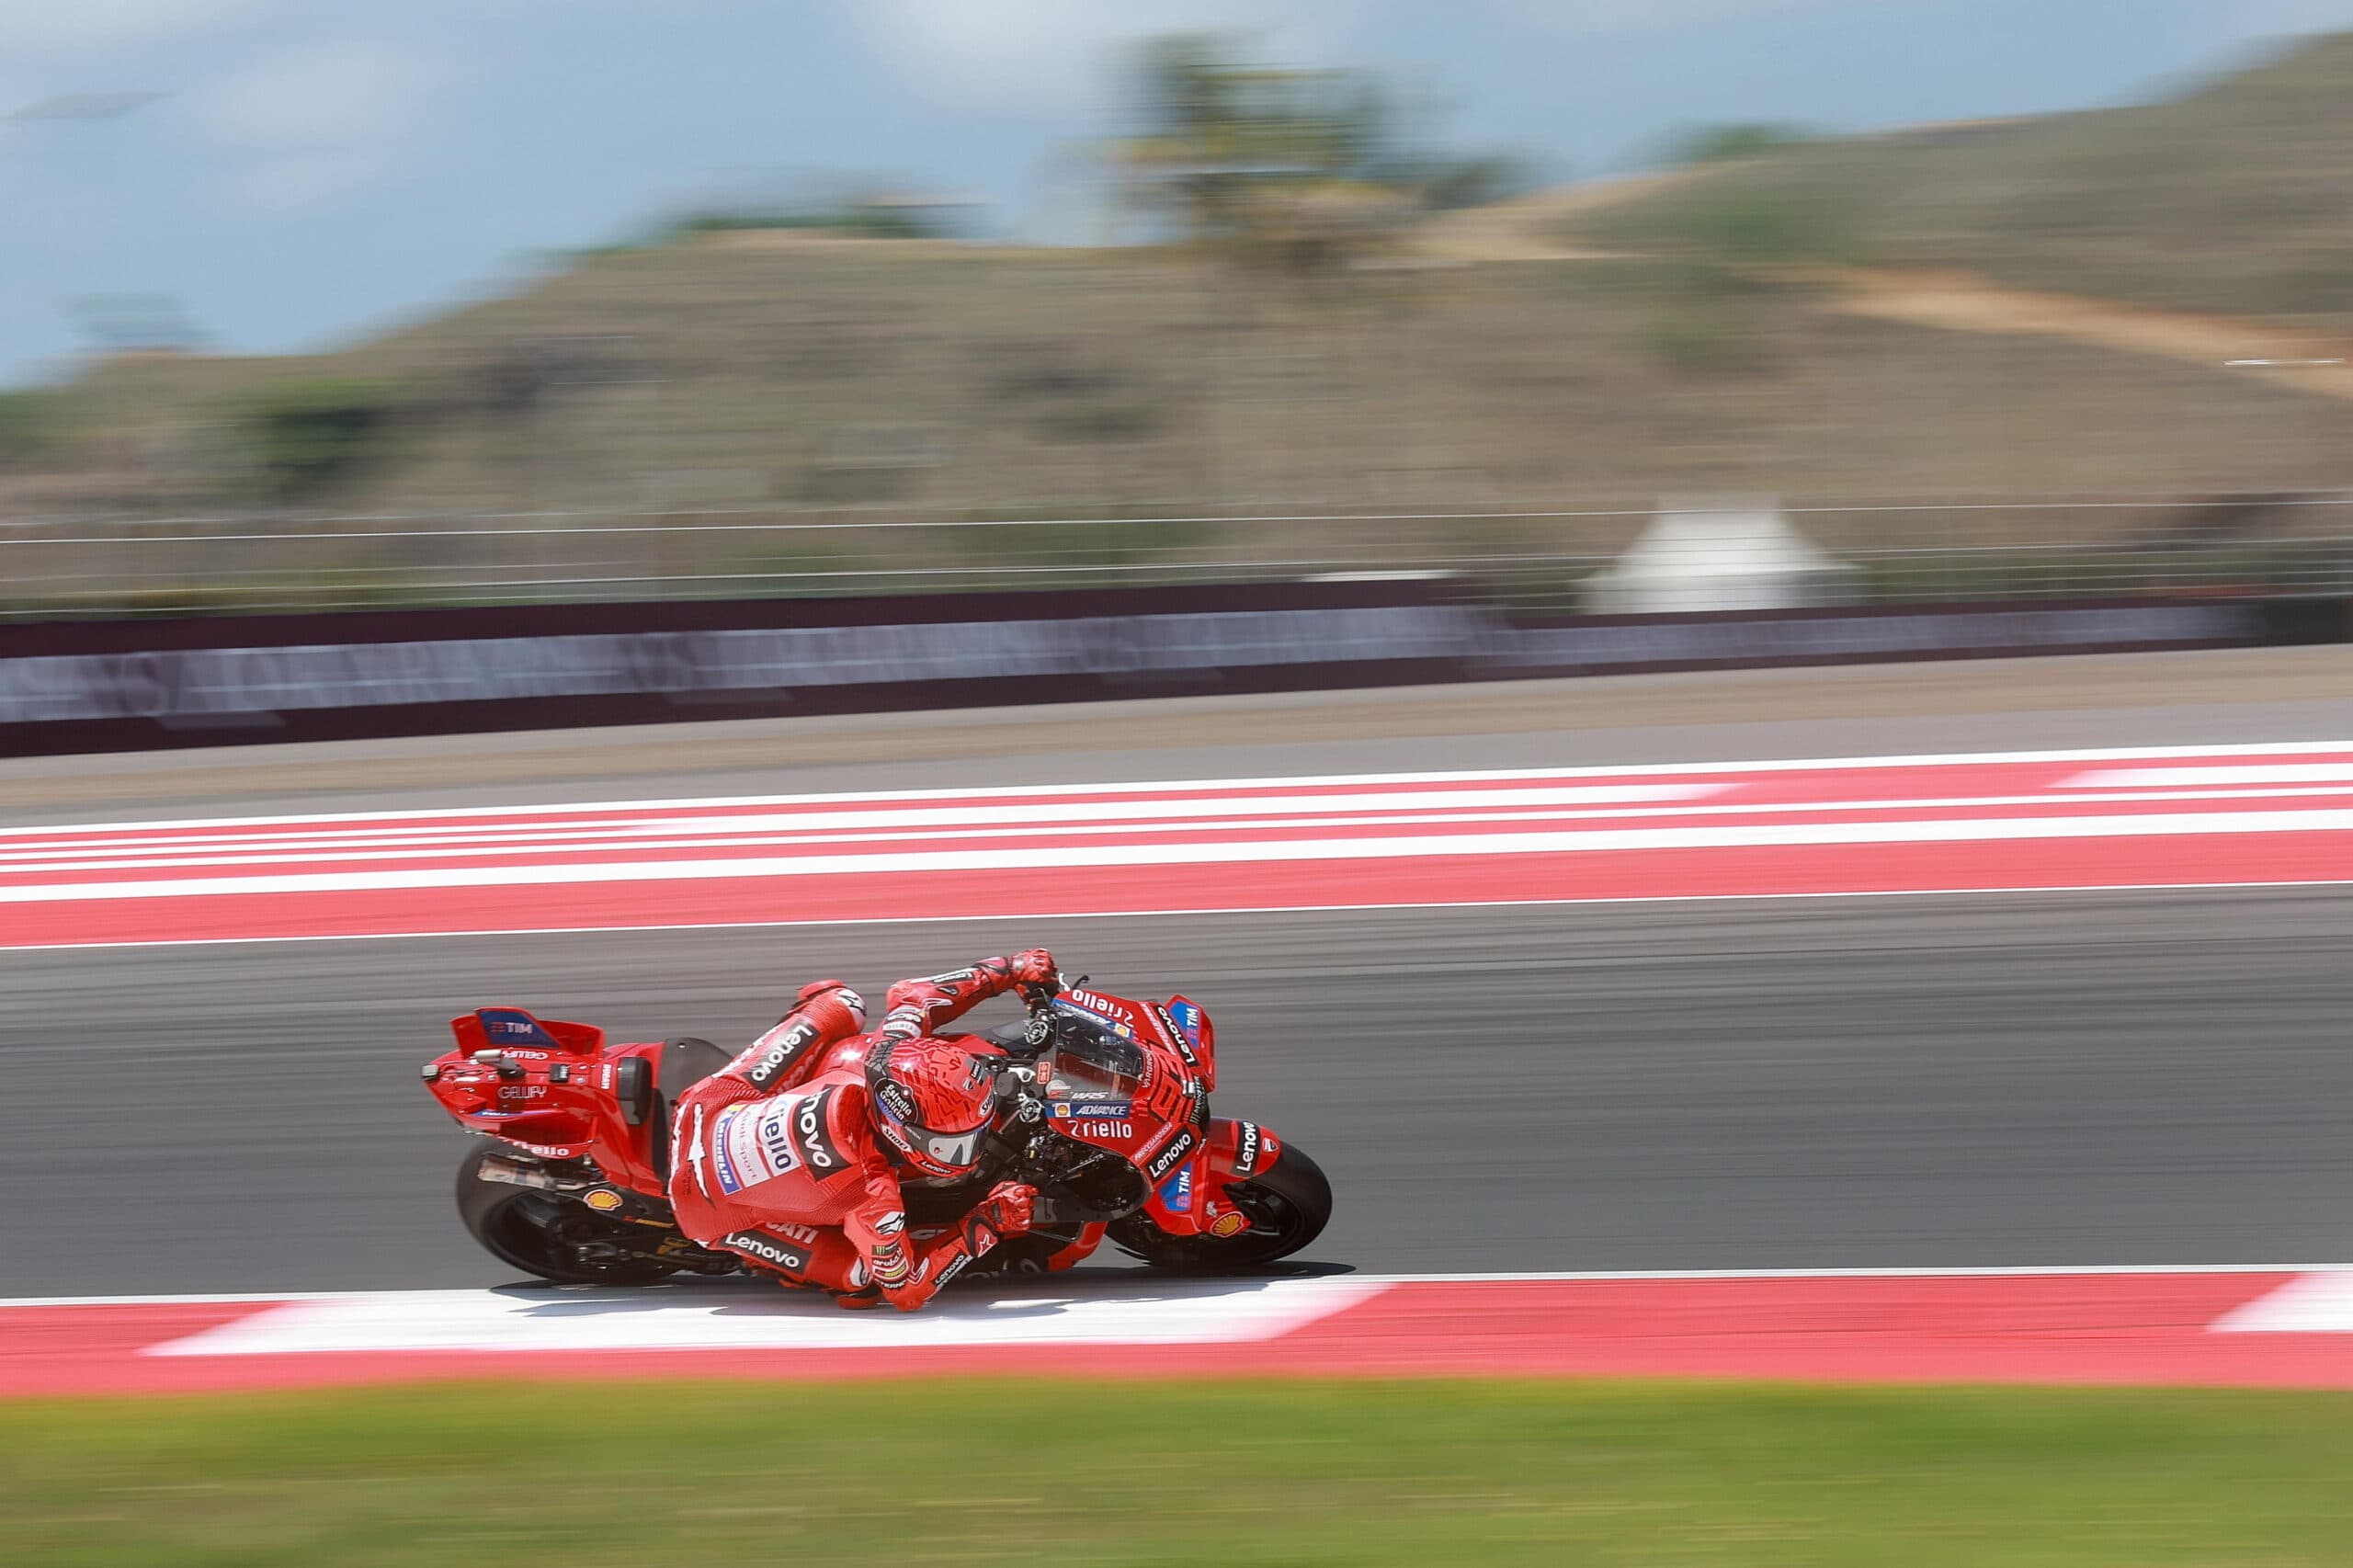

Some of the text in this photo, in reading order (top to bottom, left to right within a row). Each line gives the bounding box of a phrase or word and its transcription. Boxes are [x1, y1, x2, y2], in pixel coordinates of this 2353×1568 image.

[1072, 990, 1123, 1018] riello
[1187, 1008, 1198, 1027] TIM
[506, 1022, 533, 1035] TIM
[1158, 1006, 1196, 1063] Lenovo
[751, 1024, 813, 1082] Lenovo
[497, 1085, 548, 1100] GELLIFY
[879, 1090, 905, 1121] Galicia
[884, 1084, 913, 1117] Estrella
[1076, 1105, 1128, 1116] ADVANCE
[883, 1127, 910, 1152] SHOEI
[1082, 1120, 1132, 1138] riello
[716, 1120, 733, 1186] MICHELIN
[1149, 1132, 1192, 1179] Lenovo
[1236, 1120, 1256, 1172] Lenovo
[1178, 1170, 1191, 1194] TIM
[765, 1221, 820, 1244] CATI
[725, 1233, 801, 1268] Lenovo
[934, 1254, 965, 1285] Lenovo
